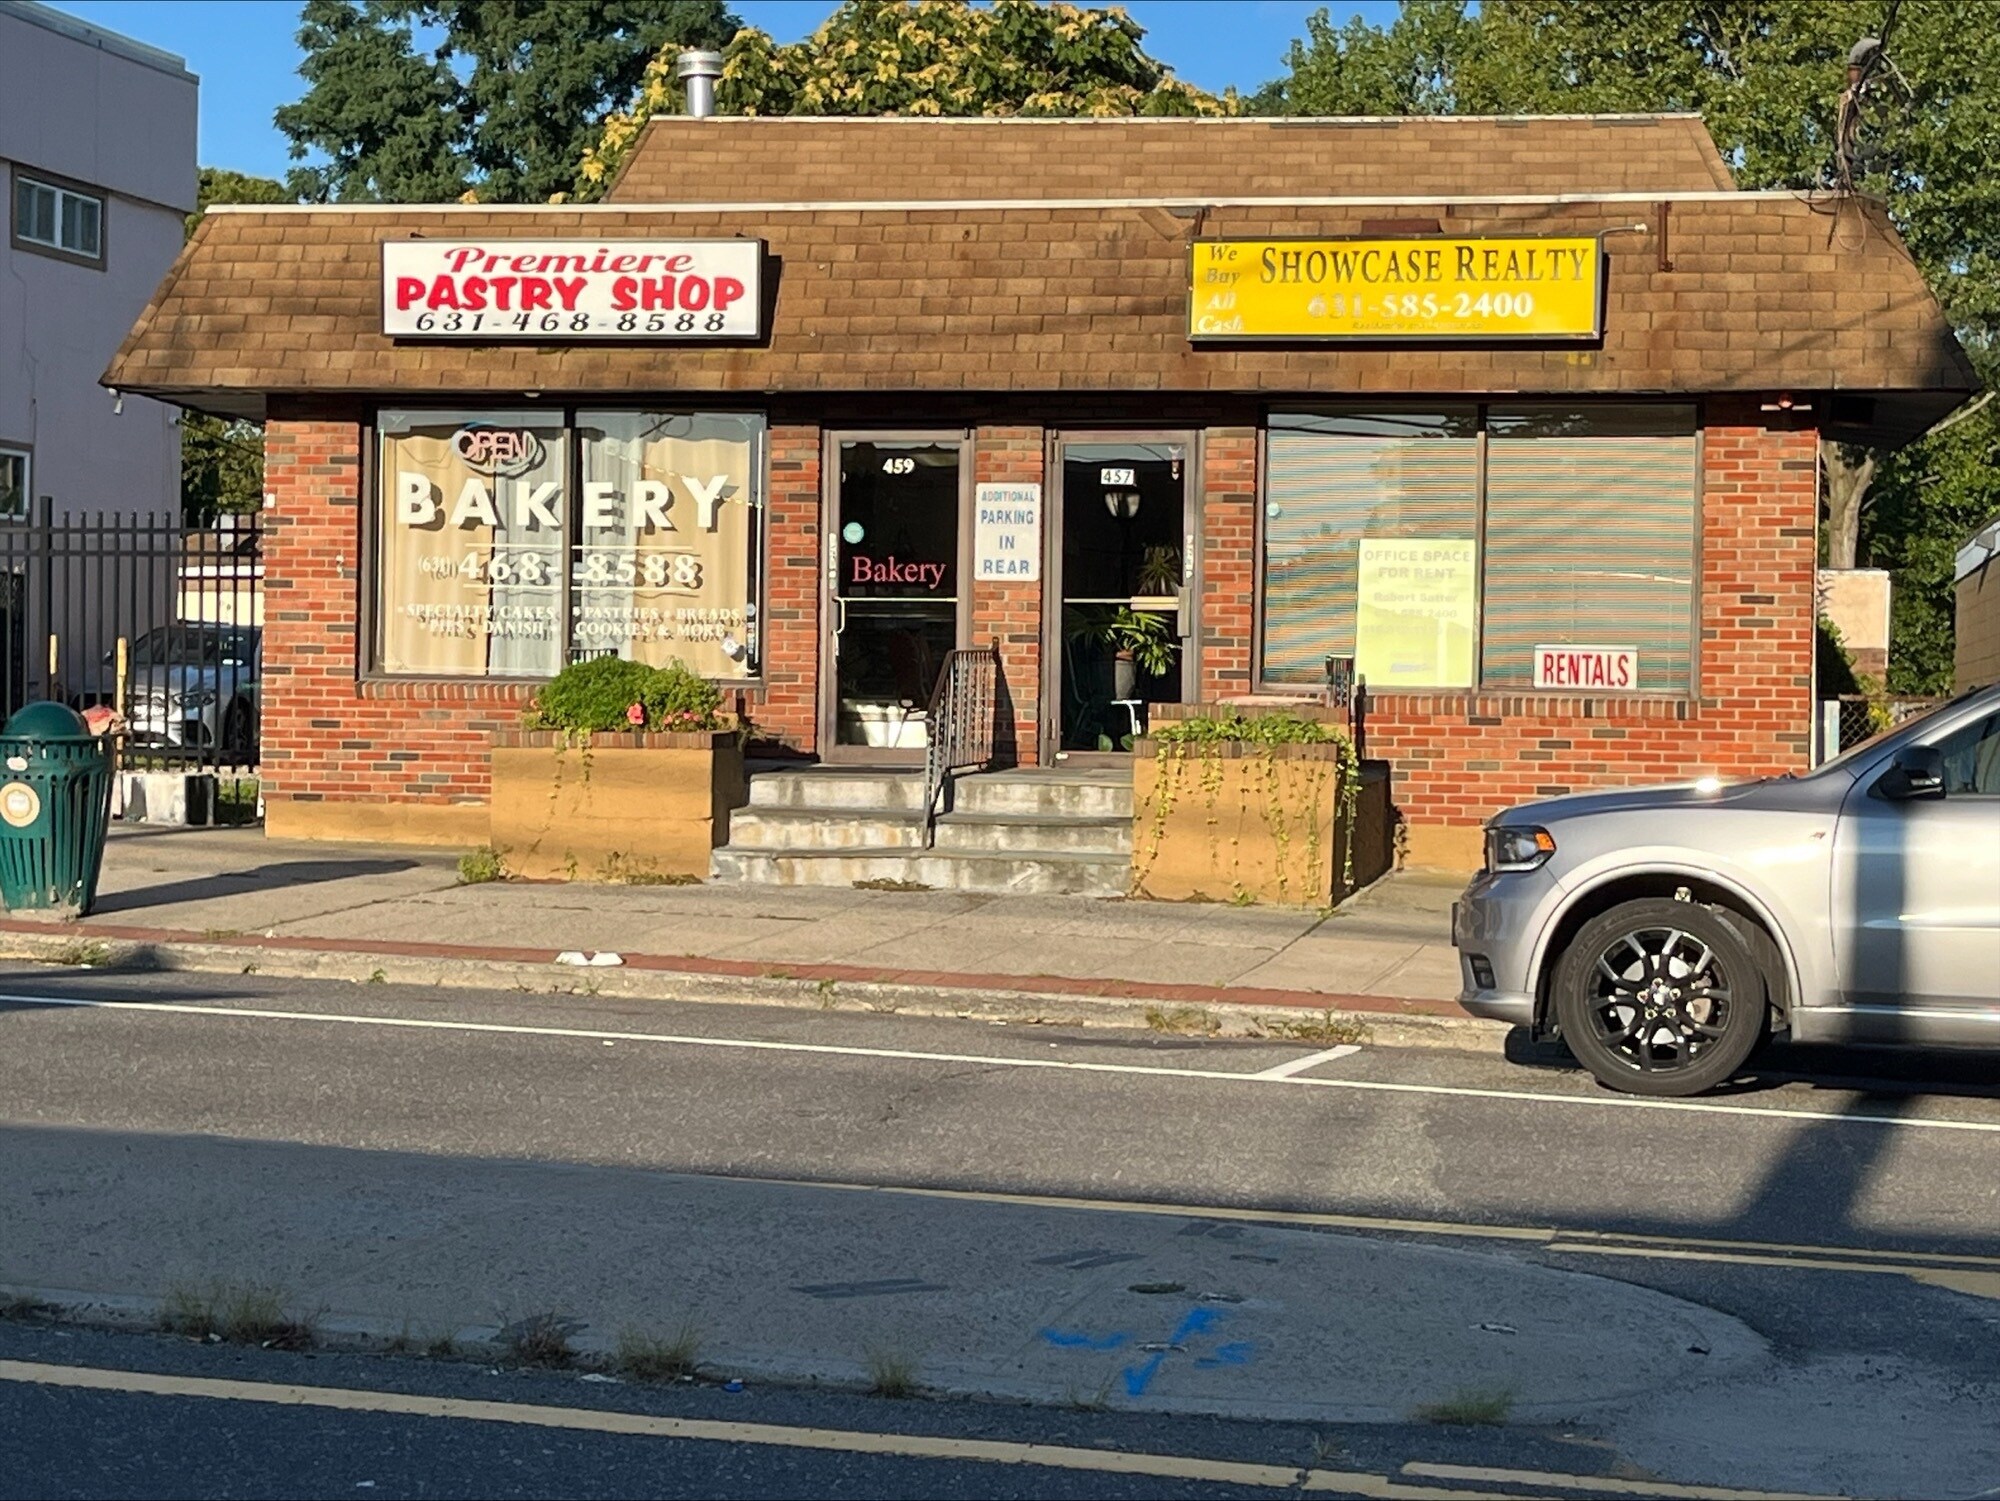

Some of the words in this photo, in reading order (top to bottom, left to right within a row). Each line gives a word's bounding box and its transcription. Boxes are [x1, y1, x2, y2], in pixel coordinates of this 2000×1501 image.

[444, 247, 697, 274] Premiere
[1209, 245, 1238, 261] We
[1260, 246, 1443, 284] SHOWCASE
[1455, 245, 1588, 282] REALTY
[397, 274, 588, 312] PASTRY
[611, 274, 745, 312] SHOP
[1307, 291, 1534, 320] 631-585-2400
[416, 312, 726, 333] 631-468-8588
[458, 431, 527, 460] OPEN
[882, 458, 915, 475] 459
[1103, 470, 1132, 484] 457
[399, 471, 729, 529] BAKERY
[981, 490, 1035, 502] ADDITIONAL
[981, 510, 1034, 525] PARKING
[999, 535, 1015, 550] IN
[1364, 550, 1418, 561] OFFICE
[1423, 551, 1471, 562] SPACE
[852, 556, 947, 589] Bakery
[983, 559, 1030, 575] REAR
[1378, 567, 1410, 578] FOR
[1414, 567, 1457, 579] RENT
[407, 604, 494, 619] SPECIALTY
[500, 605, 555, 620] CAKES
[585, 607, 659, 620] PASTRIES
[677, 608, 741, 621] BREADS
[483, 620, 547, 636] DANISH
[575, 621, 652, 637] COOKIES
[677, 624, 725, 638] MORE
[1543, 653, 1630, 688] RENTALS
